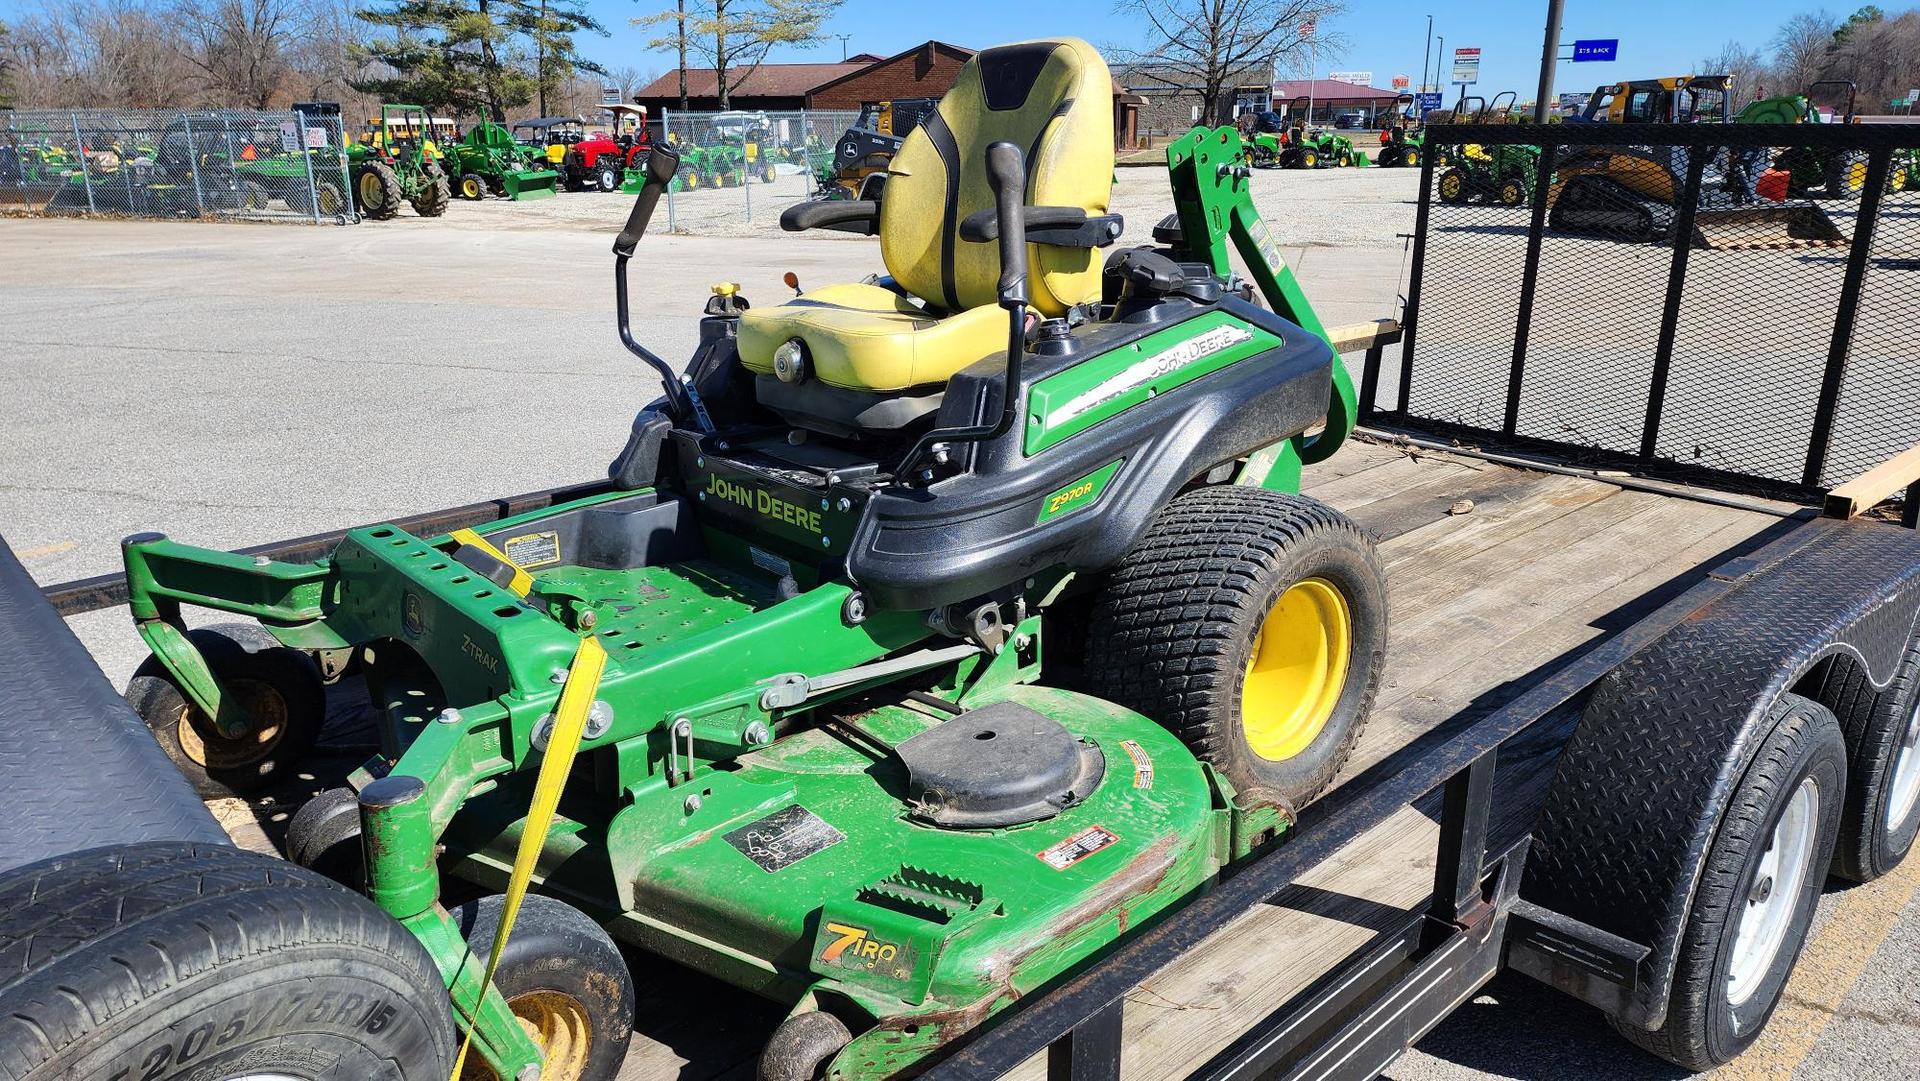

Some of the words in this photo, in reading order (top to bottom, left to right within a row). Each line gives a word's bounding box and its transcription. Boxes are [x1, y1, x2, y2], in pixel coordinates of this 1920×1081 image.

[706, 473, 753, 509] JOHN
[757, 488, 822, 534] DEERE
[1049, 481, 1093, 513] Z970R
